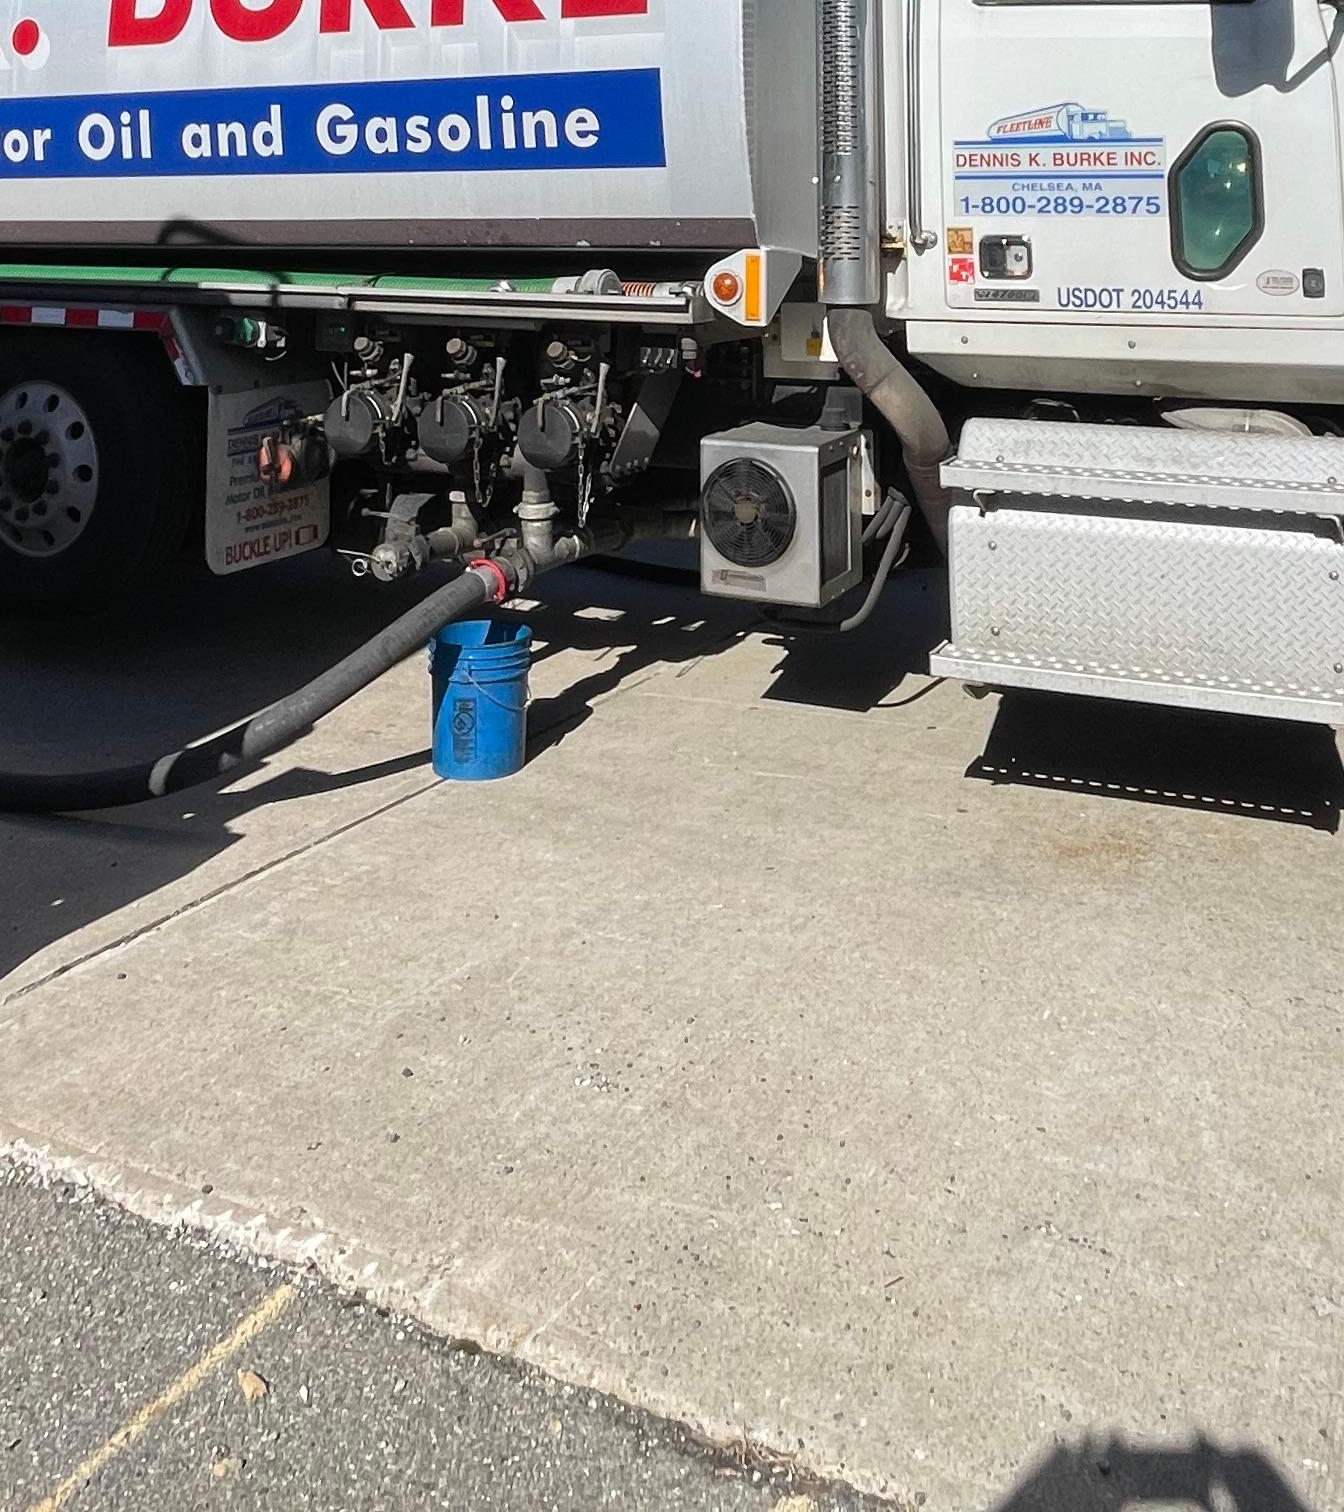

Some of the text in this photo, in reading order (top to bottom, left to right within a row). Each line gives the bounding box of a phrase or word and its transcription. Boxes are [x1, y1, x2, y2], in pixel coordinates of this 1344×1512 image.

[78, 109, 151, 161] Oil
[182, 104, 283, 159] and
[316, 95, 600, 155] Gasoline
[956, 151, 1161, 168] DENNIS K. BURKE INC.
[1012, 182, 1102, 192] CHELSEA, MA
[960, 196, 1161, 214] 1-800-289-2875
[1058, 288, 1204, 310] USDOT 204544
[225, 535, 271, 565] BUCKLE
